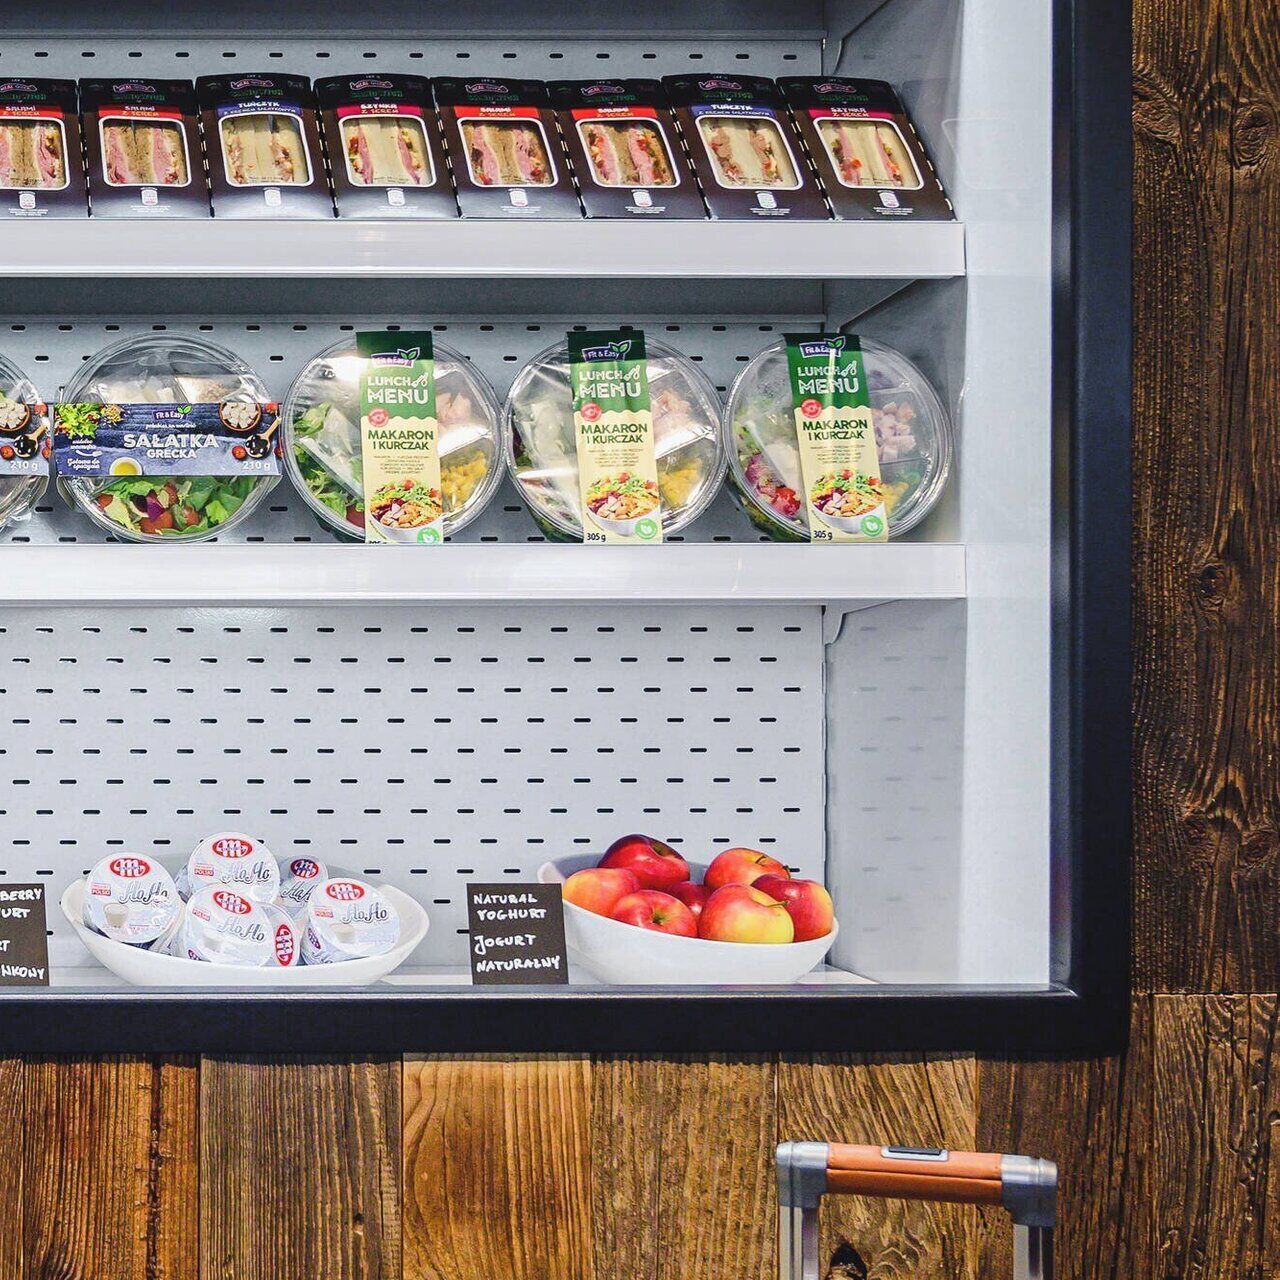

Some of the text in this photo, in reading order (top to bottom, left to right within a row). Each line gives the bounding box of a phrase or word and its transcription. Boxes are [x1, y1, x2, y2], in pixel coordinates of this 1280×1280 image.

[604, 350, 620, 358] Easy
[579, 370, 623, 381] LUNCH
[797, 367, 841, 376] LUNCH
[367, 377, 412, 386] LUNCH
[799, 378, 859, 394] MENU
[580, 382, 641, 398] MENU
[367, 389, 429, 404] MENU
[581, 423, 648, 434] MAKARON
[803, 420, 868, 430] MAKARON
[123, 433, 219, 448] SAŁATKA
[368, 430, 434, 440] MAKARON
[586, 434, 643, 444] I KURCZAK
[815, 431, 864, 441] KURCZAK
[373, 441, 429, 450] I KURCZAK
[146, 448, 197, 459] GRECKA
[10, 460, 39, 471] 210 g
[243, 461, 271, 471] 210 g
[586, 532, 606, 543] 305 g
[814, 531, 833, 542] 305 g
[473, 893, 538, 904] NATURAL
[477, 908, 547, 921] YOGHURT
[474, 934, 537, 955] JOGURT
